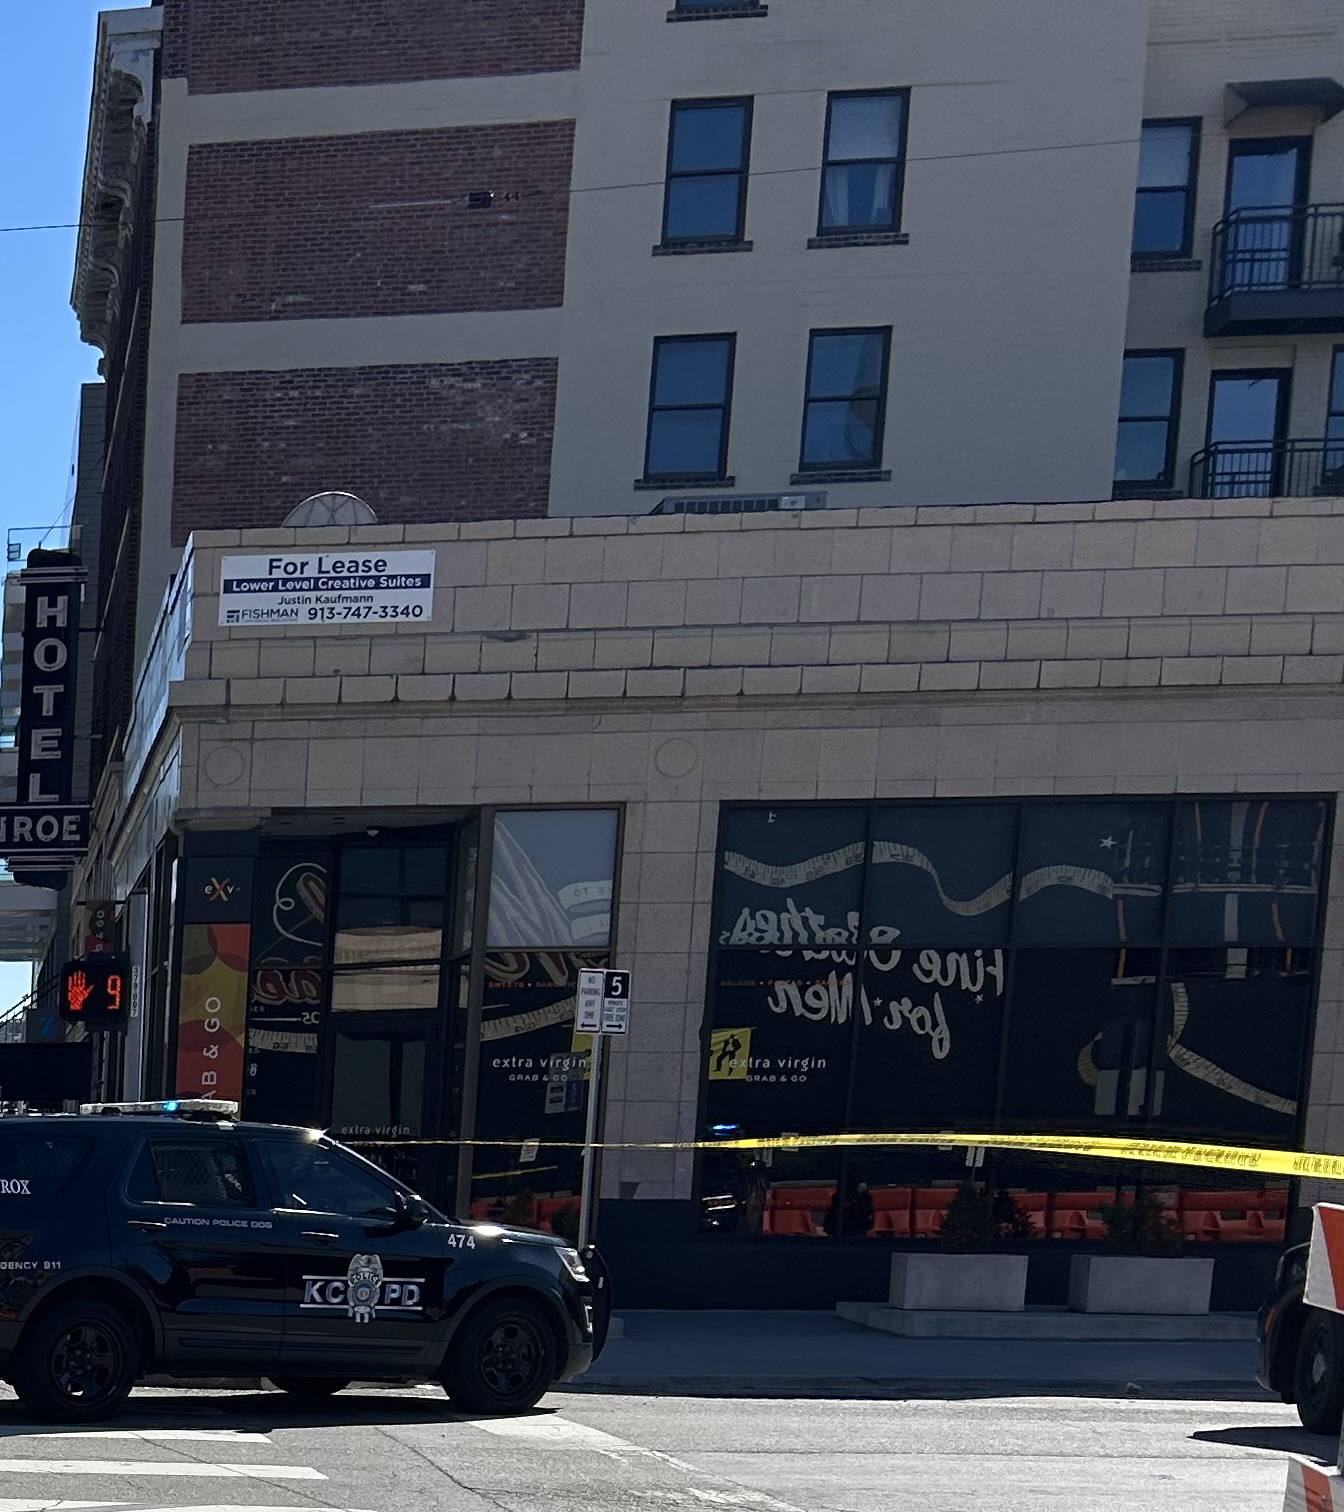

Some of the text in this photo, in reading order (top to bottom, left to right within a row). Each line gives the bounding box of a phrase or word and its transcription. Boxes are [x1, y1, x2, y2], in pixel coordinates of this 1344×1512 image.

[268, 556, 388, 576] For Lease
[233, 576, 422, 592] Lower Level Creative Suites
[277, 593, 374, 606] Justin Kaufmann
[241, 608, 299, 620] FISHMAN
[307, 604, 423, 621] 913-747-3340
[28, 595, 69, 803] HOTEL
[107, 975, 121, 1010] 9
[611, 976, 622, 996] 5
[204, 996, 221, 1032] GO
[202, 1044, 218, 1059] &
[492, 1056, 587, 1072] extra virgin
[728, 1056, 827, 1072] extra virgin
[508, 1074, 539, 1082] GRAB
[745, 1074, 808, 1083] GRAB & GO
[341, 1124, 411, 1138] extra virgin
[0, 1178, 31, 1195] ROX
[163, 1216, 273, 1229] CAUTION POLICE DOG
[447, 1232, 477, 1250] 474
[43, 1260, 63, 1271] 911
[303, 1278, 421, 1306] KC PD
